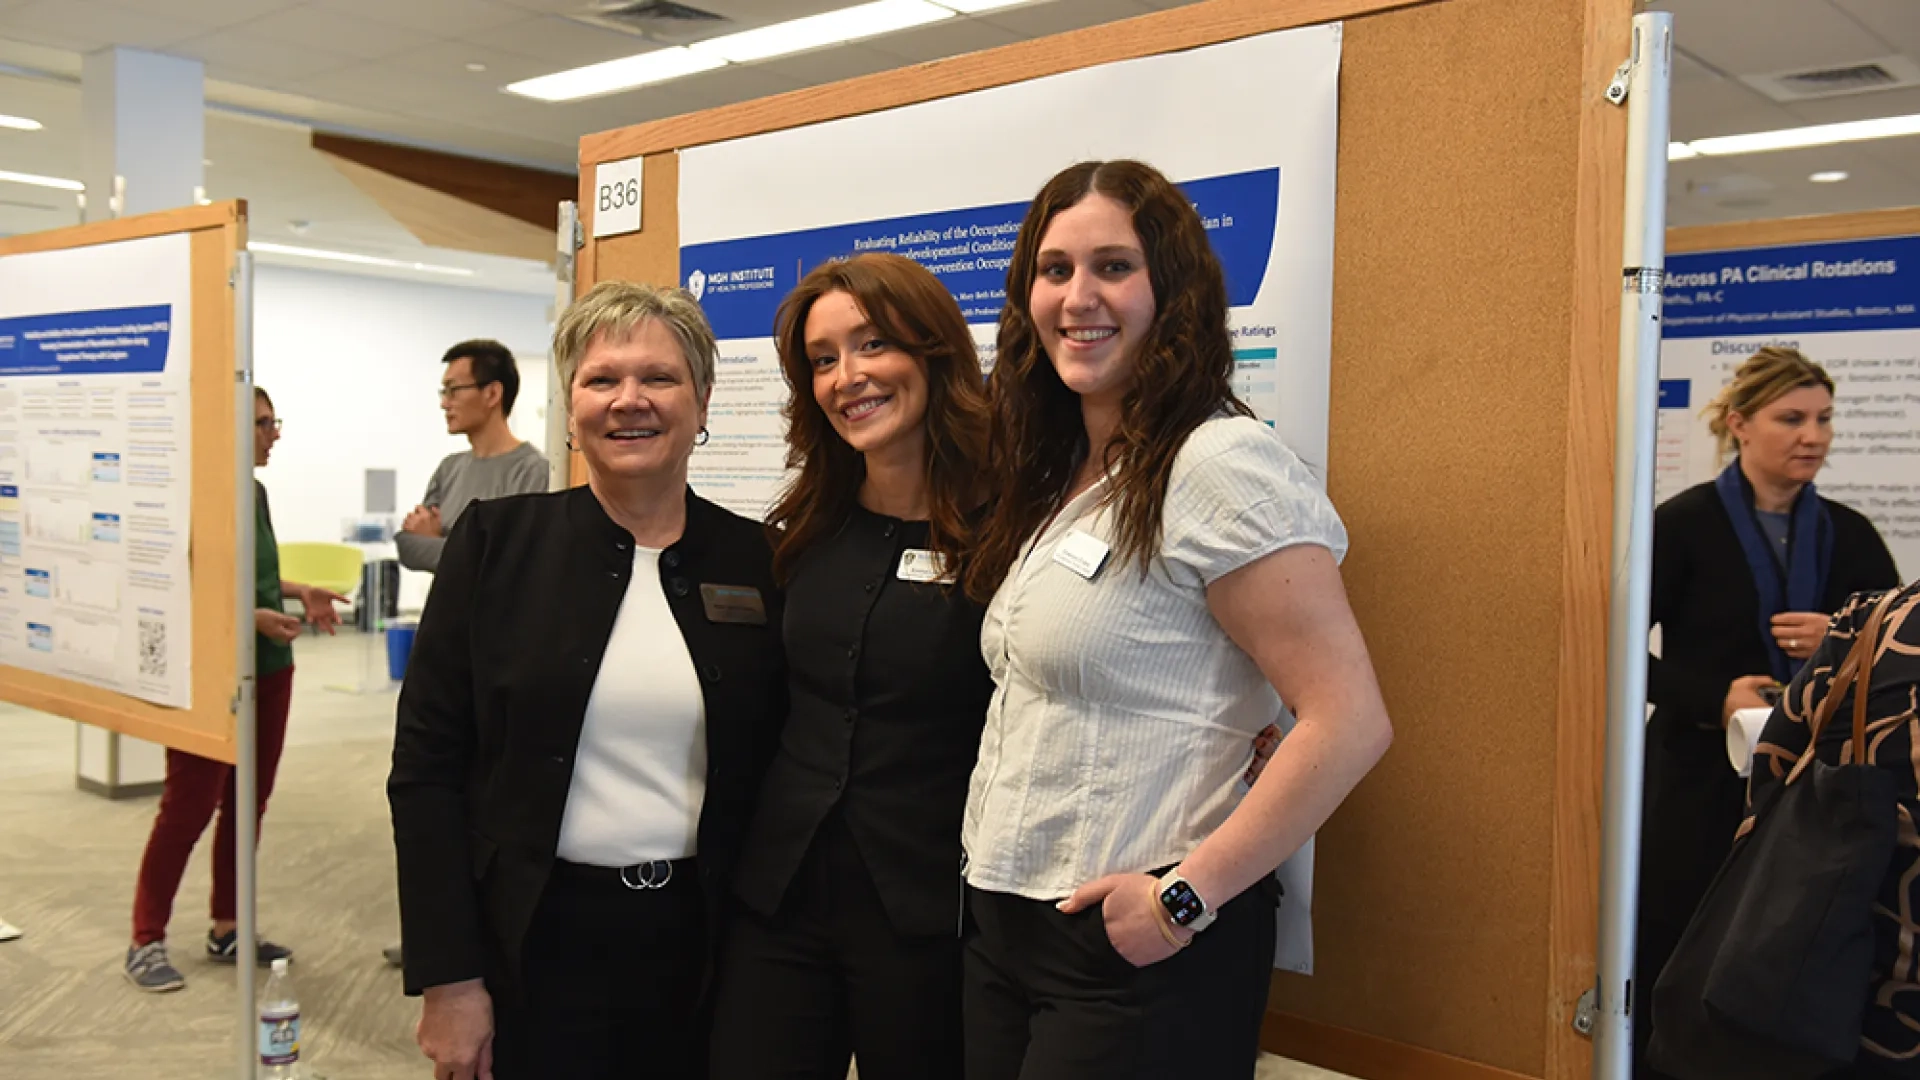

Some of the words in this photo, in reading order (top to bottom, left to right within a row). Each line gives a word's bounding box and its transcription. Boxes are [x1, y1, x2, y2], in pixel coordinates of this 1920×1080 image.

[599, 178, 638, 212] B36
[854, 234, 897, 250] Evaluating
[899, 229, 940, 245] Reliability
[942, 227, 954, 240] of
[954, 225, 968, 239] the
[708, 272, 729, 285] MGH
[730, 267, 774, 282] INSTITUTE
[1662, 270, 1717, 288] Across
[1720, 266, 1743, 285] PA
[1746, 262, 1808, 283] Clinical
[1812, 258, 1897, 278] Rotations
[1696, 289, 1725, 303] PA-C
